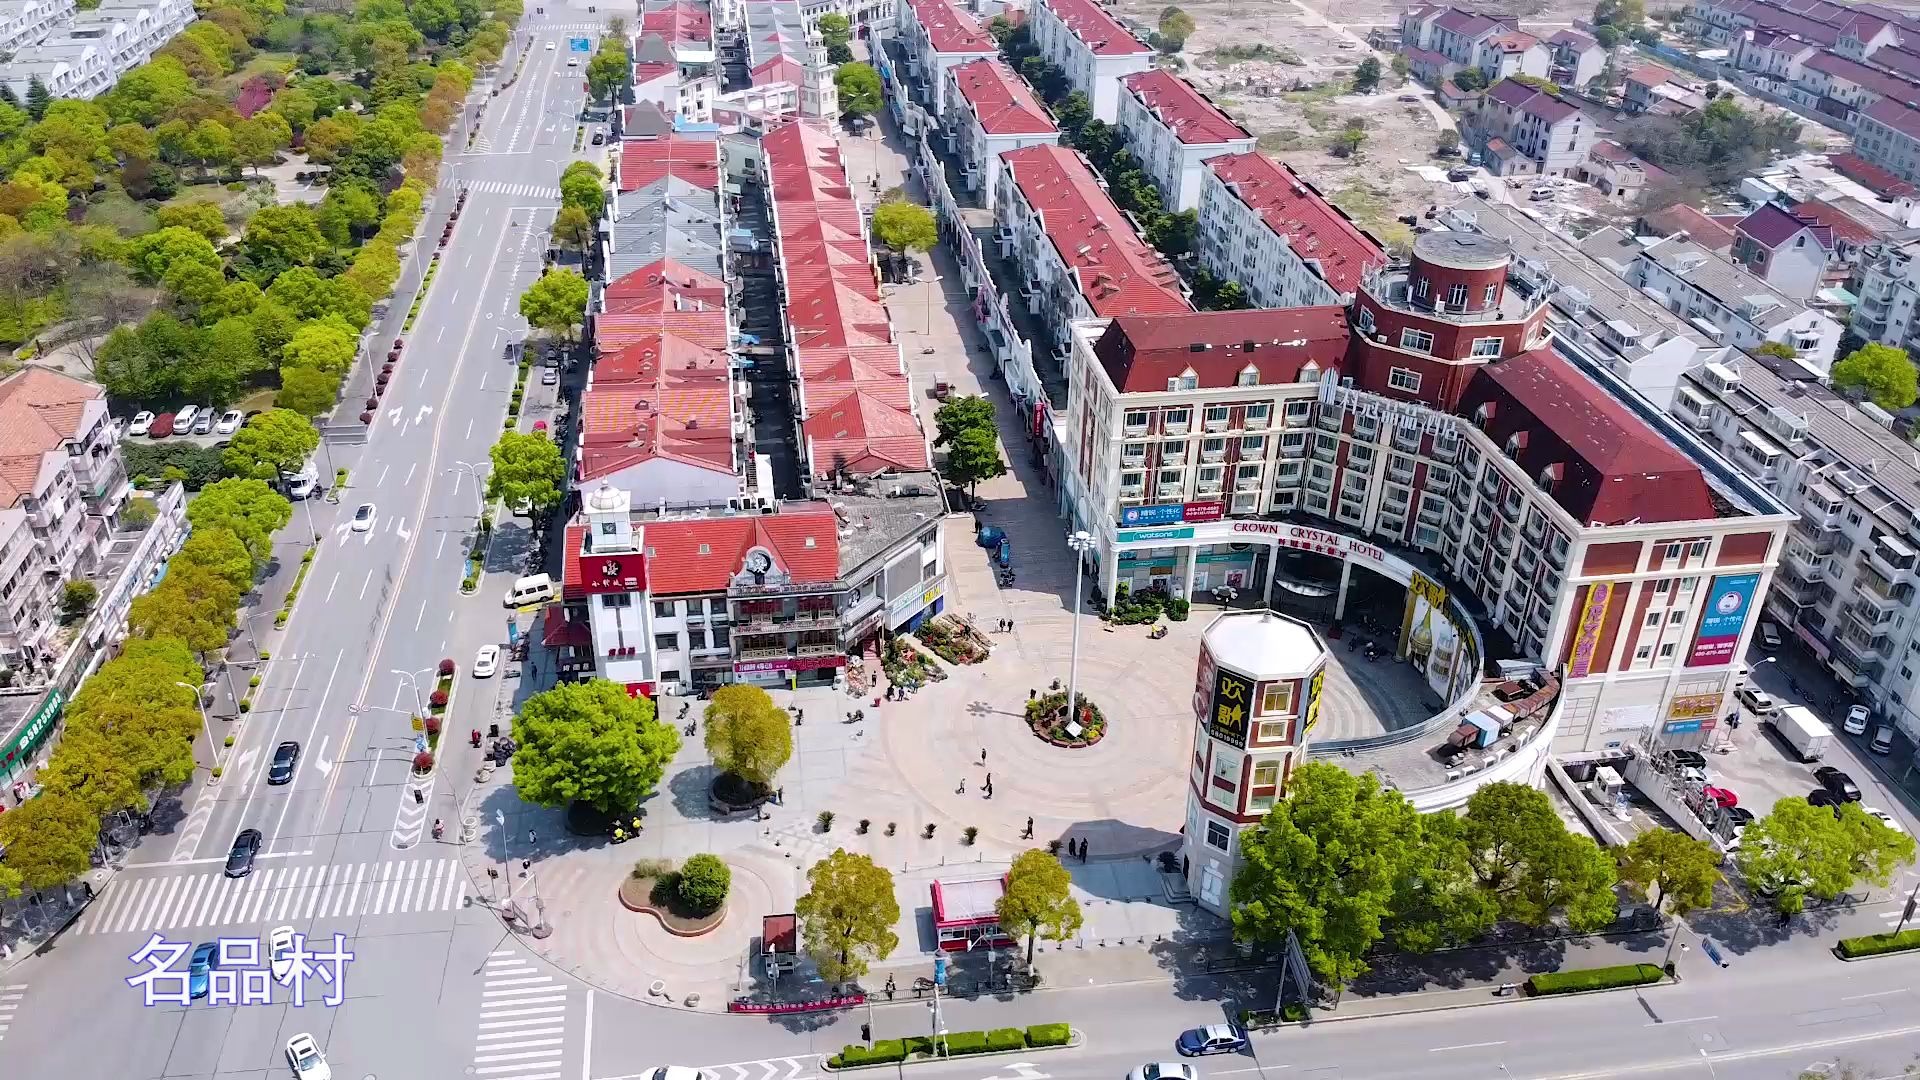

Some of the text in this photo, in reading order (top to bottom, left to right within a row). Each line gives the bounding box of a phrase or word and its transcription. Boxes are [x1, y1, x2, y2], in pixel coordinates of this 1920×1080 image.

[1139, 530, 1174, 539] watsons
[1233, 522, 1279, 534] CROWN
[1290, 527, 1340, 546] CRYSTAL
[1349, 541, 1385, 562] HOTEL
